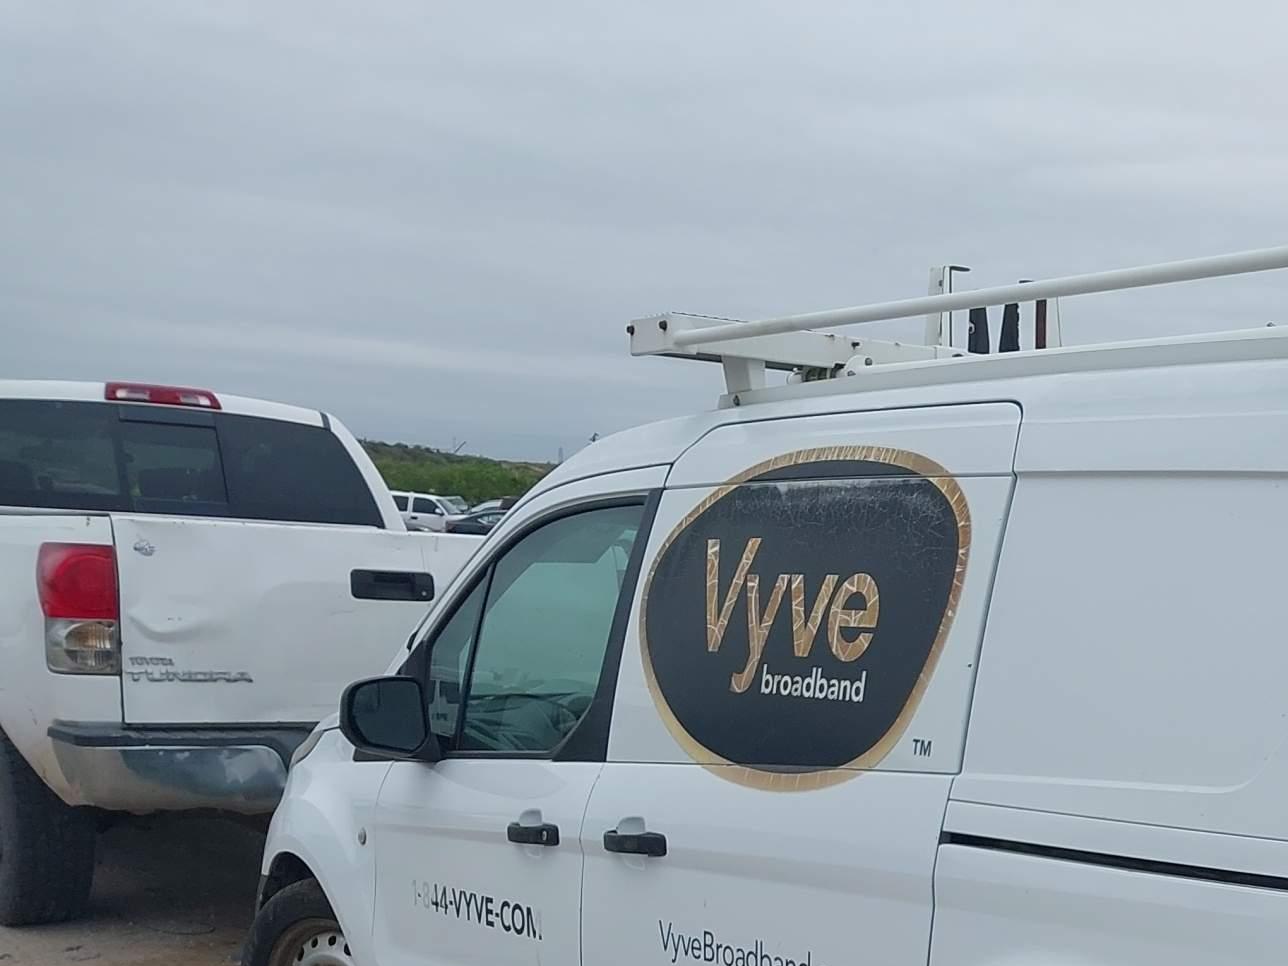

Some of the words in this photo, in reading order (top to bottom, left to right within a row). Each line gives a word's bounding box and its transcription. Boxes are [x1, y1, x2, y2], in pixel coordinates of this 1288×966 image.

[706, 537, 880, 693] Vyve
[760, 664, 867, 702] broadband
[912, 739, 932, 757] TM
